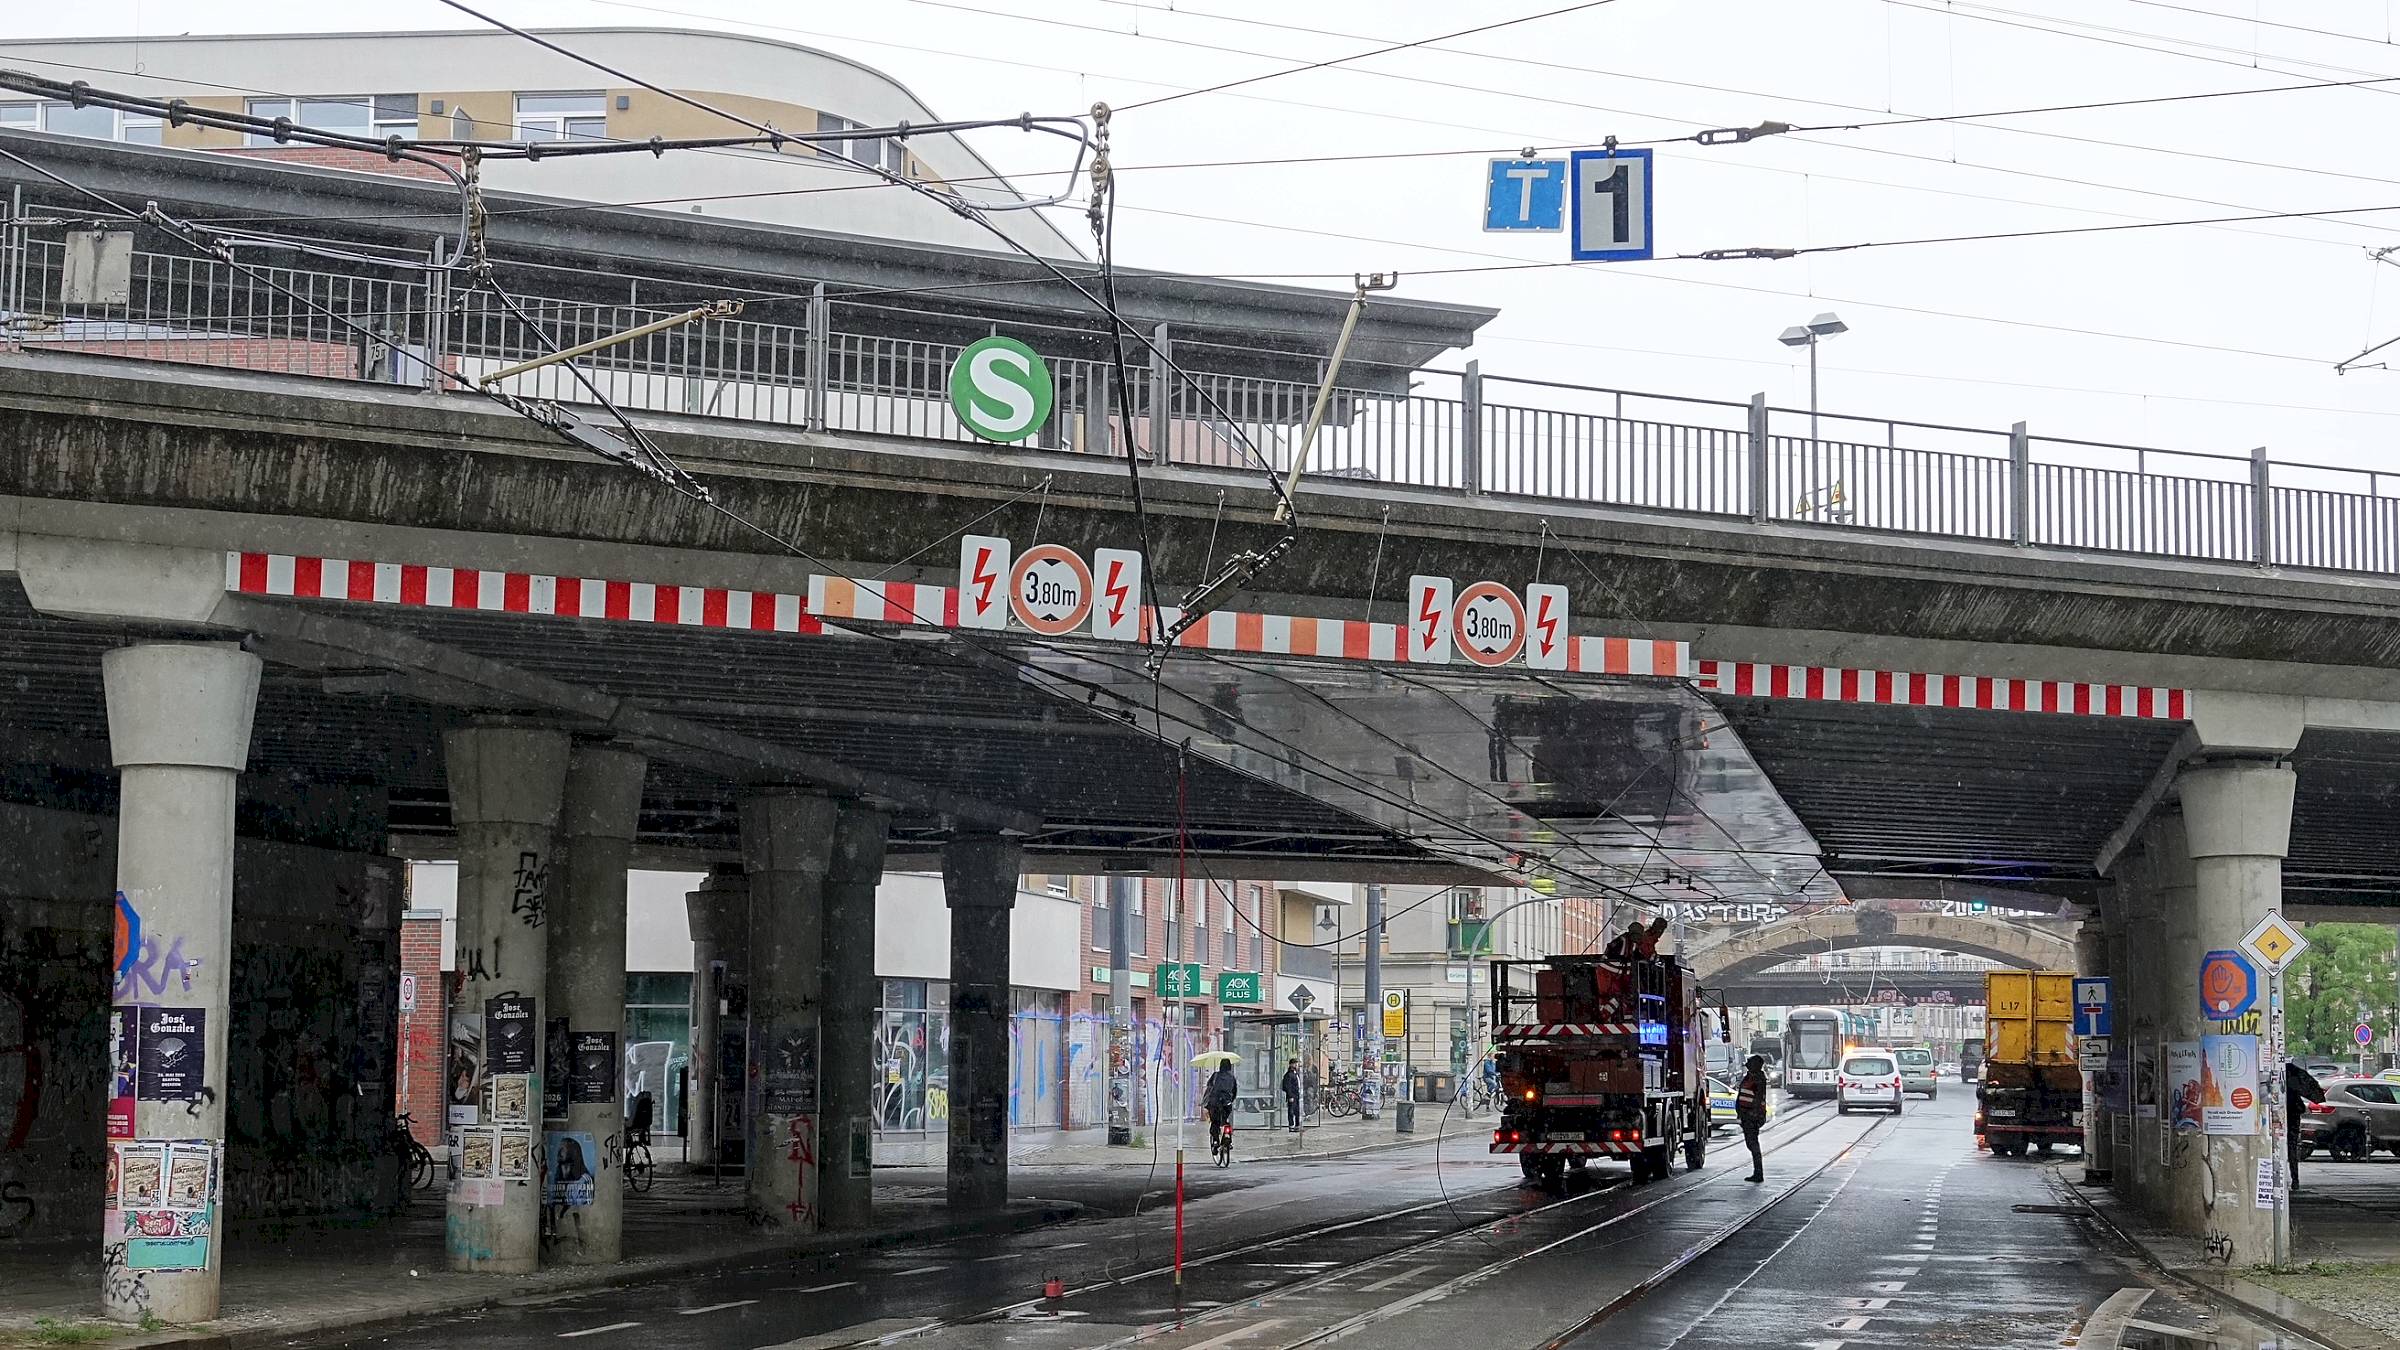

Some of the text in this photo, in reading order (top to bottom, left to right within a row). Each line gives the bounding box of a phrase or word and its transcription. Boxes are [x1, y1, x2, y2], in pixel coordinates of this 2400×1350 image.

[1506, 168, 1549, 222] T
[1594, 164, 1630, 243] 1
[969, 347, 1035, 433] S
[1025, 571, 1076, 607] 3,80m
[1466, 607, 1512, 640] 3,80m
[1167, 969, 1191, 981] AOK
[1226, 977, 1250, 989] AOK
[1225, 991, 1250, 999] PLUS
[150, 1021, 195, 1033] González
[161, 1013, 185, 1025] José
